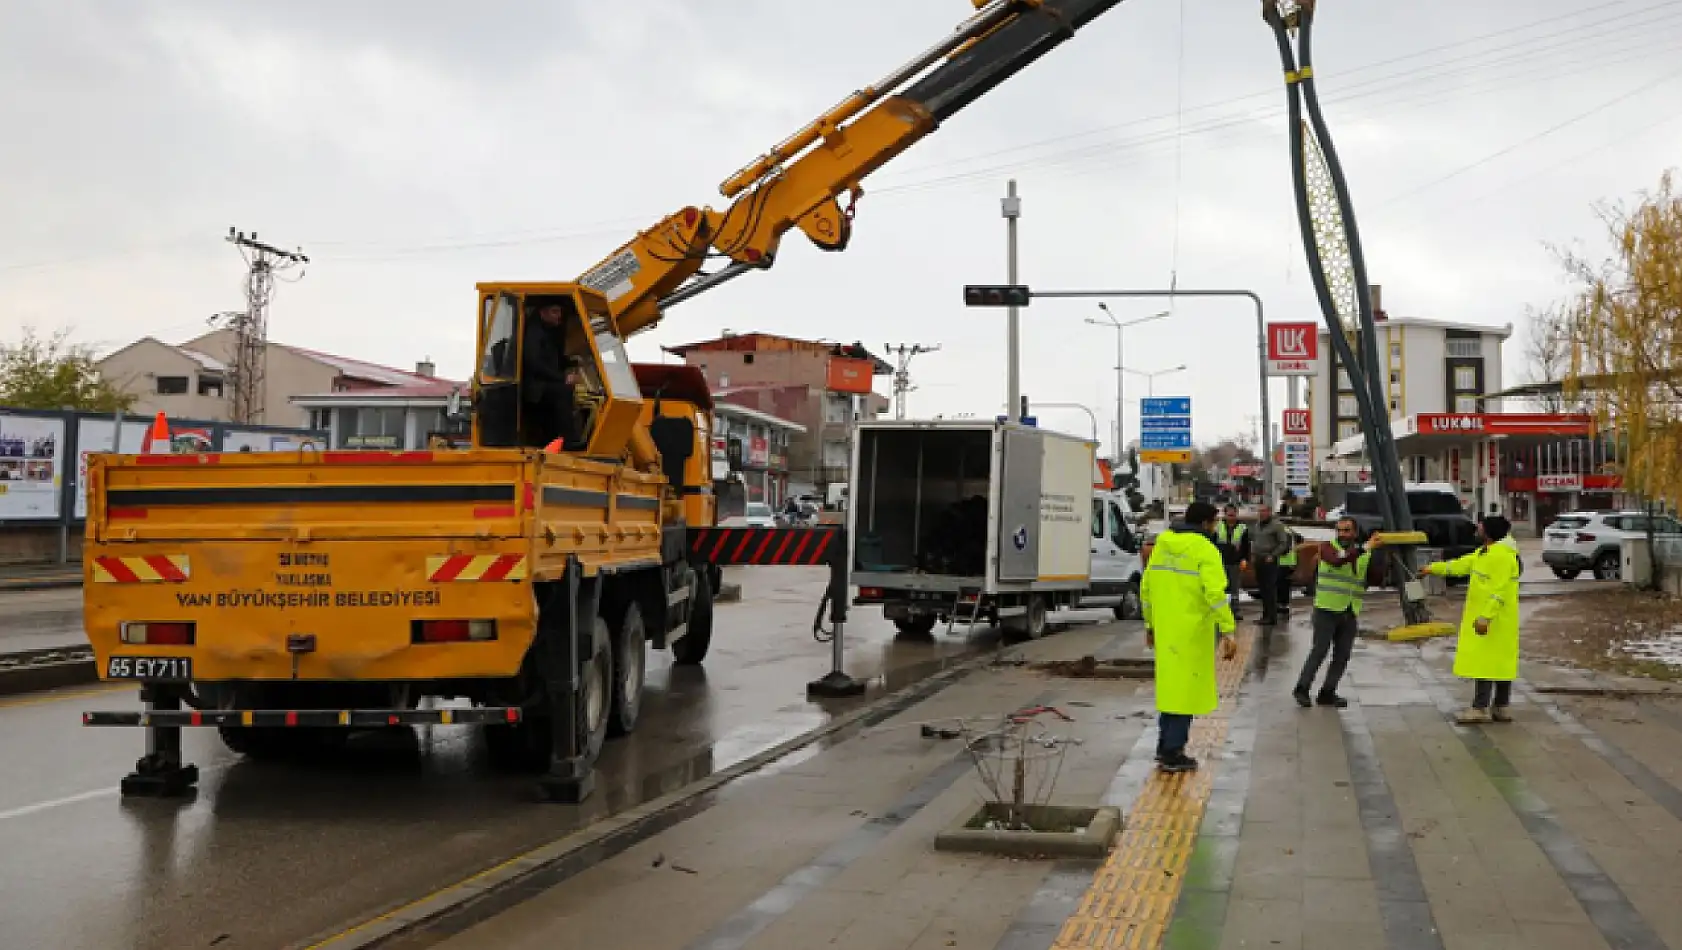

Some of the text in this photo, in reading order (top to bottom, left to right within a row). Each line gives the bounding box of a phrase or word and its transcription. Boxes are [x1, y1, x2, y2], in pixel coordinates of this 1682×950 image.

[176, 588, 441, 611] VAN BÜYÜKŞEHİR BELEDİYESİ
[110, 658, 130, 677] 65
